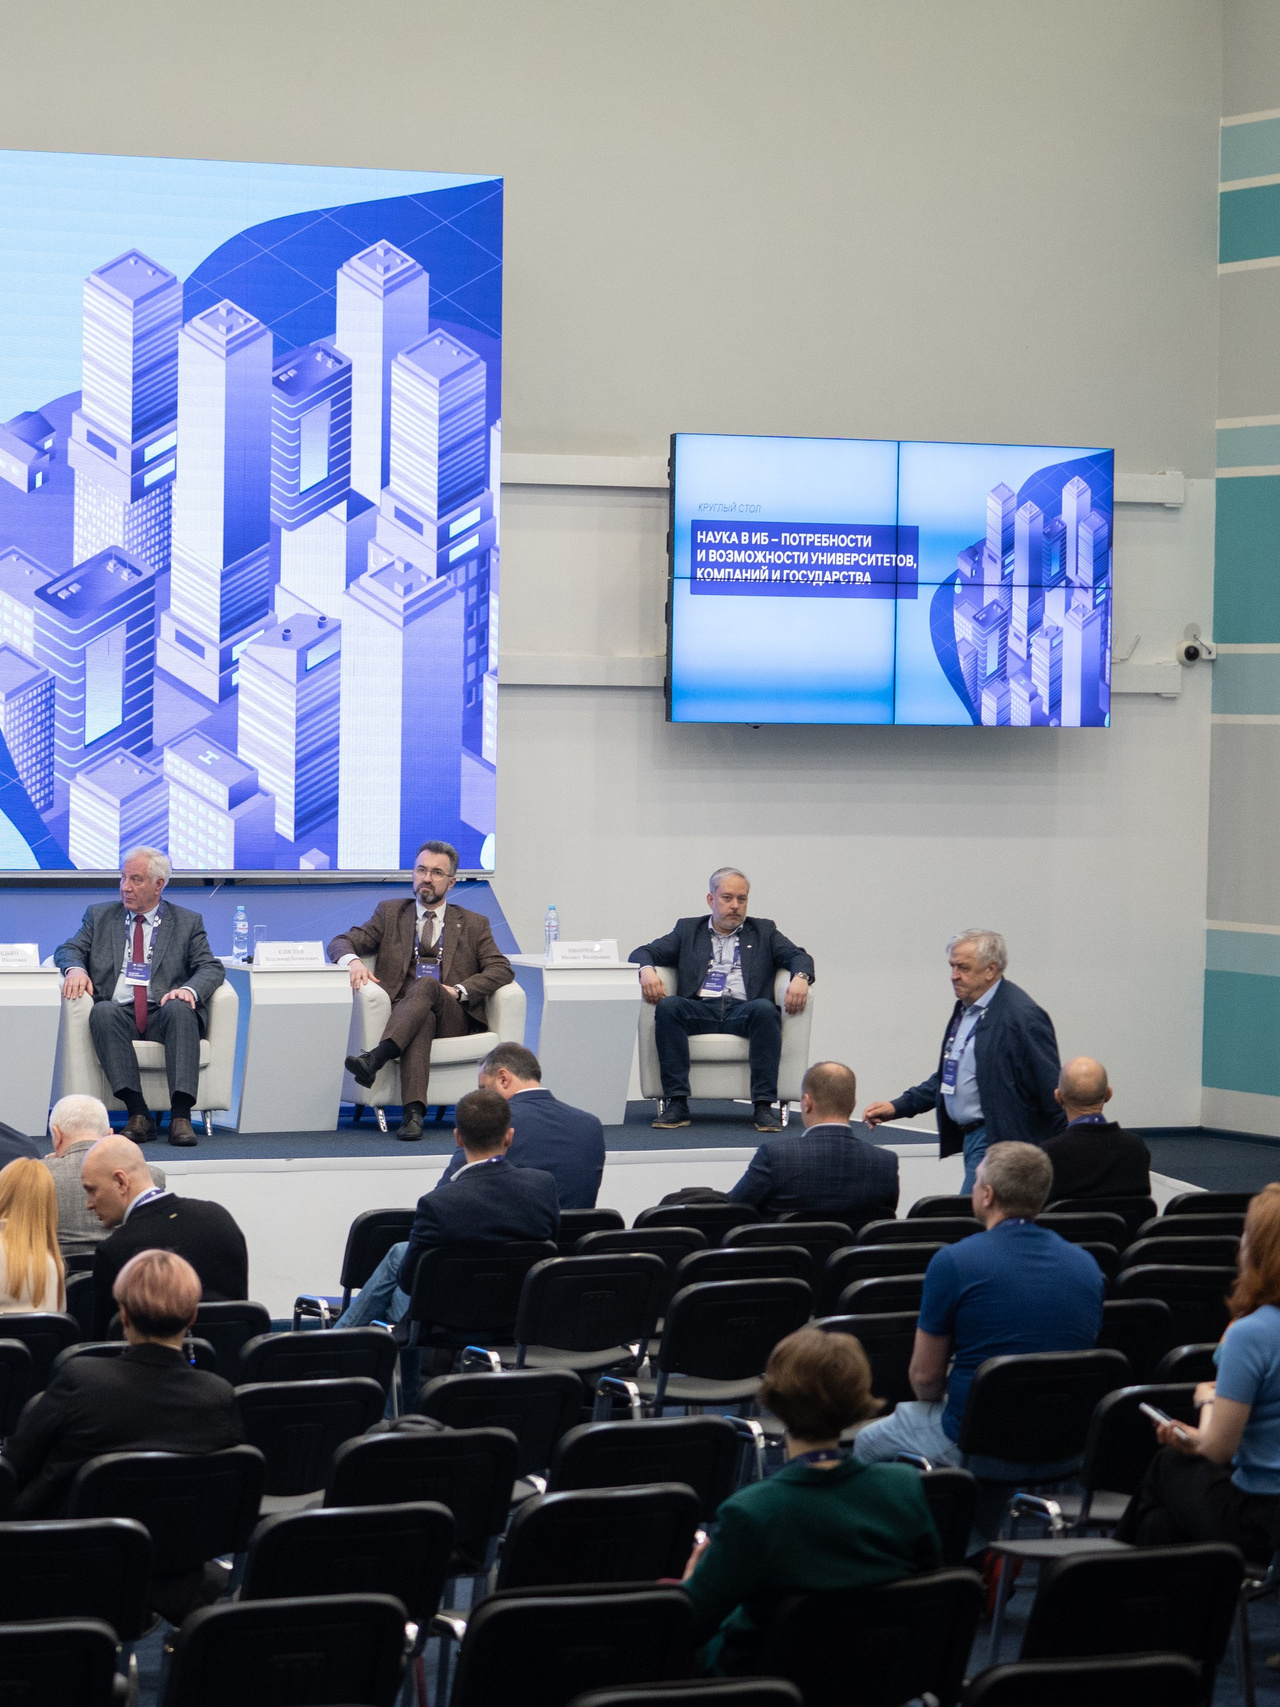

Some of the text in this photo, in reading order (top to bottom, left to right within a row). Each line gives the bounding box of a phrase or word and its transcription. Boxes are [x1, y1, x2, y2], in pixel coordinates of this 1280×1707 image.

[698, 502, 762, 514] КРУГЛЫЙ СТОЛ
[697, 530, 739, 544] НАУКА
[741, 532, 750, 545] В
[751, 532, 769, 545] ИБ
[781, 532, 872, 548] ПОТРЕБНОСТИ
[697, 549, 917, 569] И ВОЗМОЖНОСТИ УНИВЕРСИТЕТОВ,
[696, 565, 872, 586] КОМПАНИЙ И ГОСУДАРСТВА
